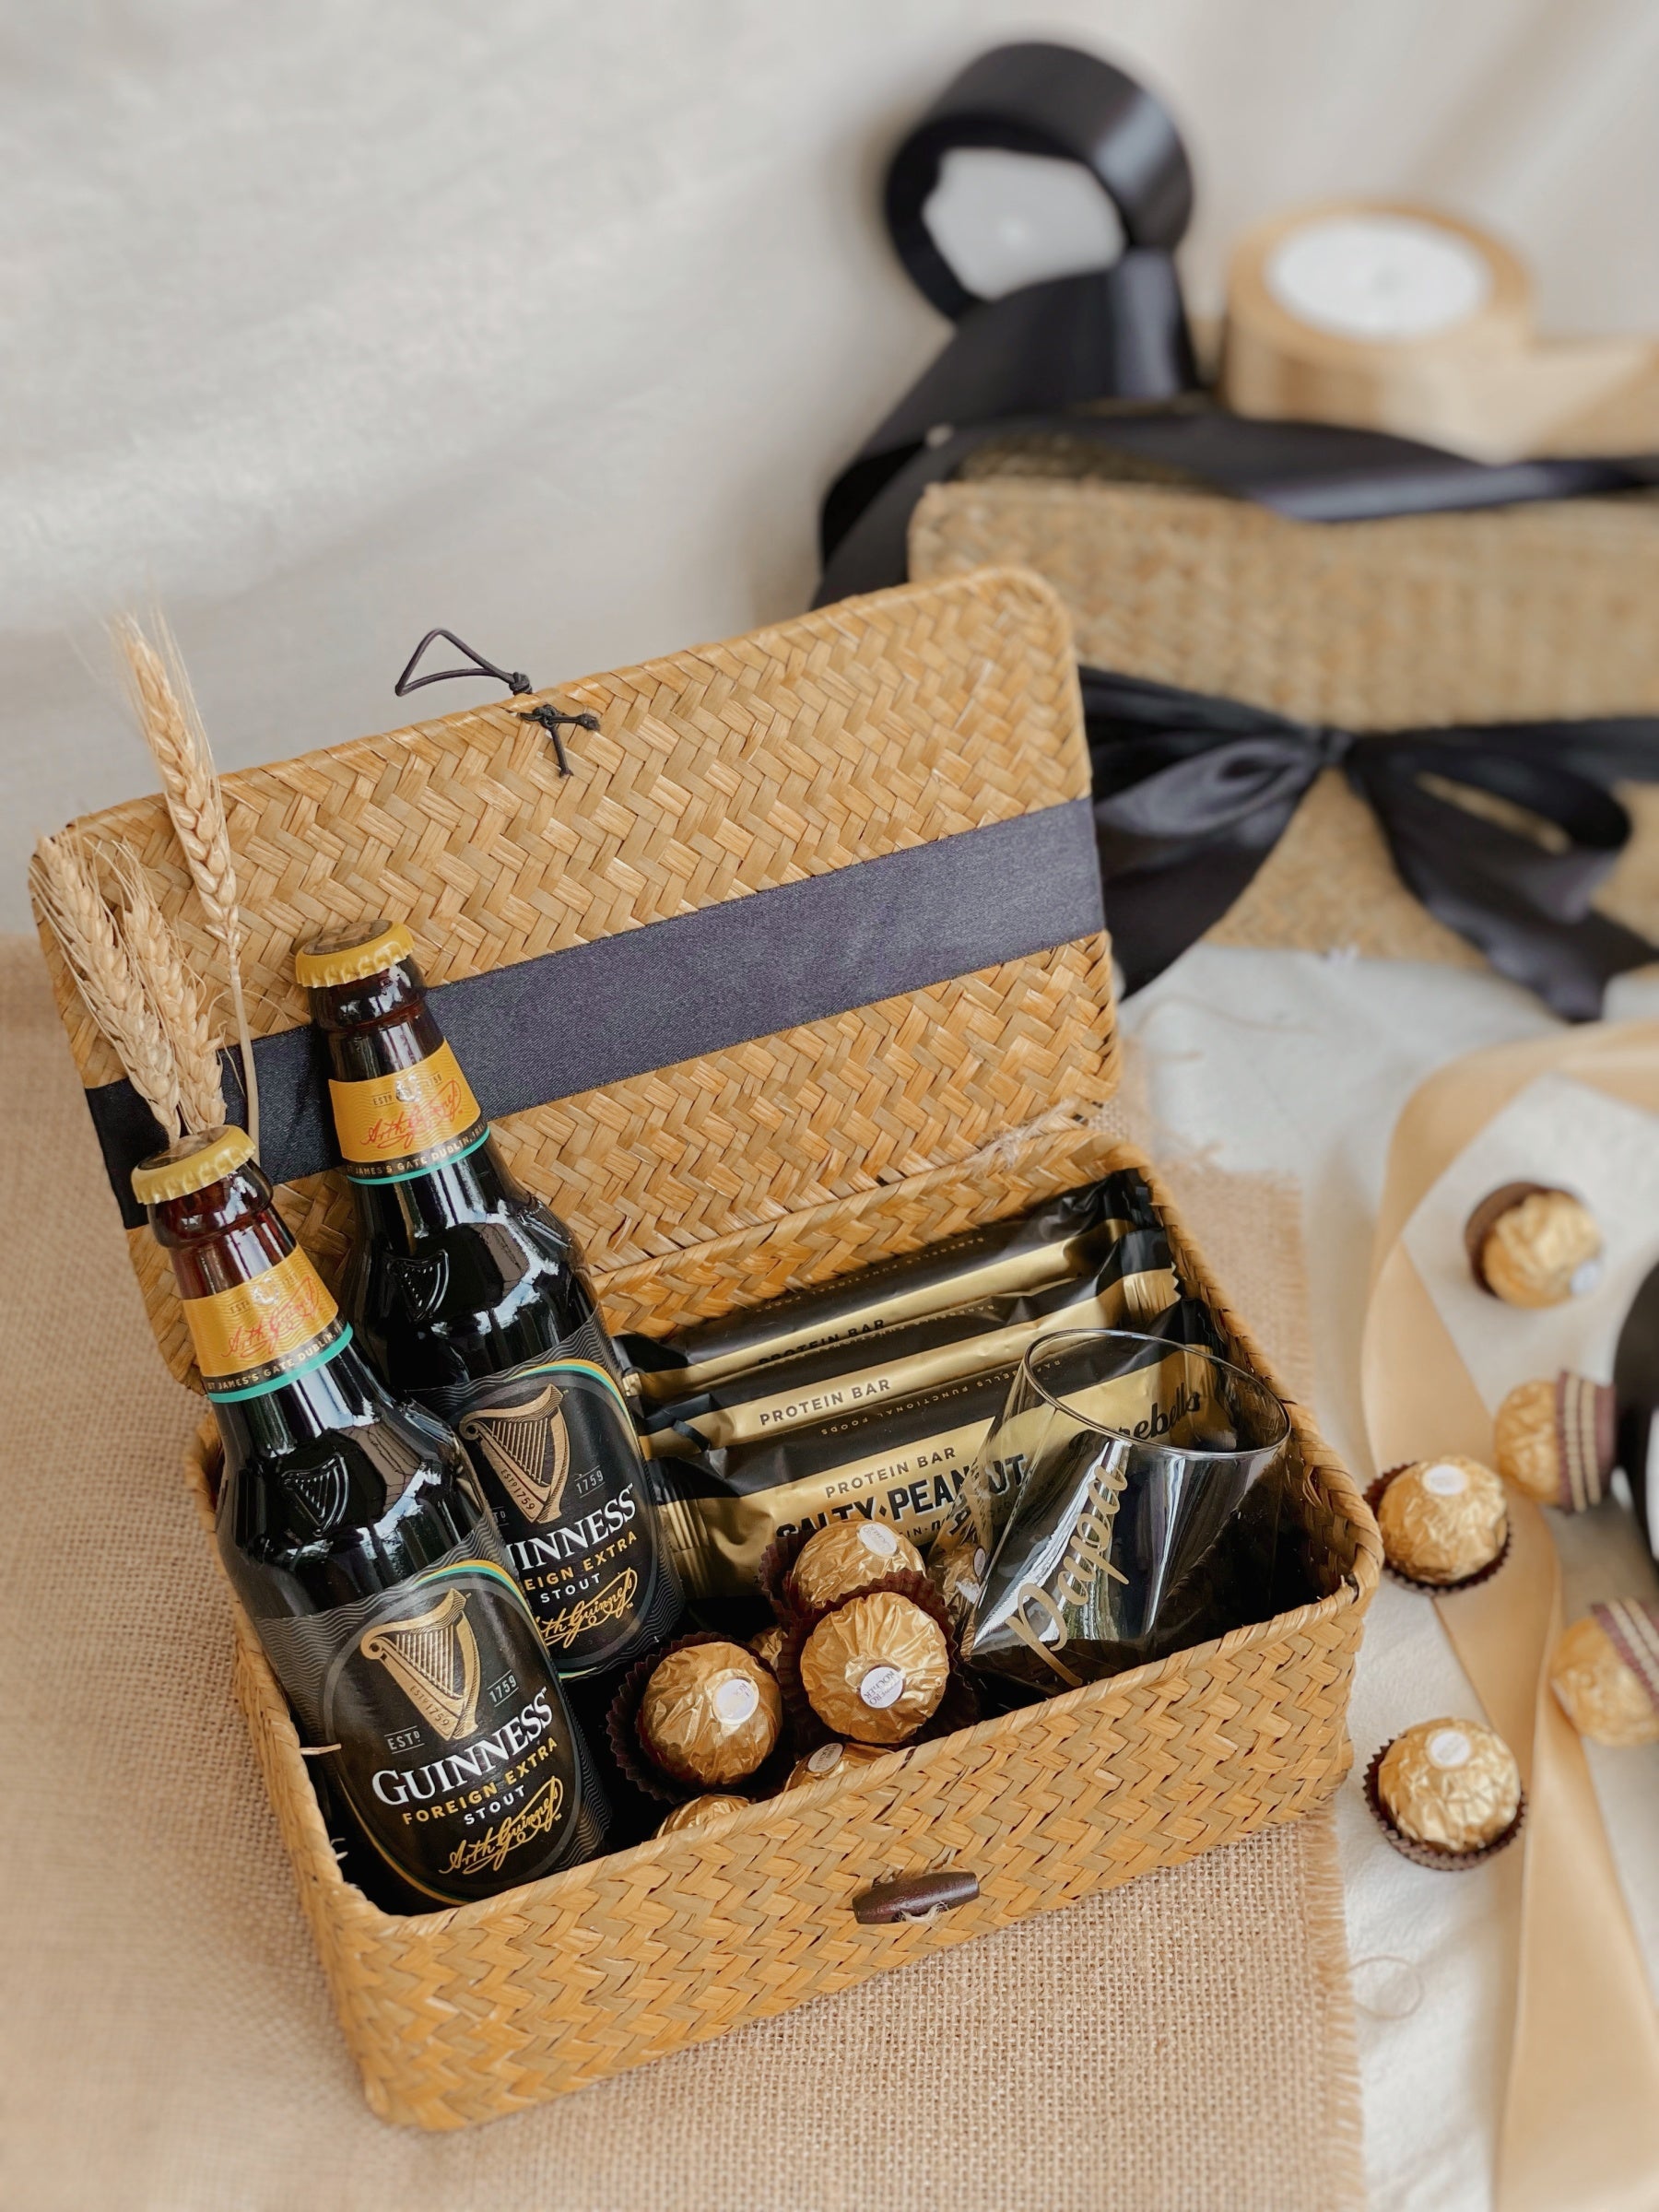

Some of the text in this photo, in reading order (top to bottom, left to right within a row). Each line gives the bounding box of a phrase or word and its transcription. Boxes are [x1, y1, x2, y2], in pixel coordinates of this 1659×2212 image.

[397, 1157, 428, 1171] GATE
[264, 1356, 295, 1377] GATE
[759, 1378, 891, 1427] PROTEIN BAR
[876, 1386, 970, 1419] FUNCTIONAL
[820, 1418, 869, 1436] FOODS
[574, 1470, 605, 1495] 1759
[825, 1446, 957, 1499] PROTEIN BAR
[516, 1485, 537, 1512] 1759
[524, 1530, 638, 1592] EIGN EXTRA
[1005, 1465, 1130, 1688] Papa
[540, 1572, 600, 1604] STOUT
[488, 1674, 519, 1703] 1759
[424, 1703, 450, 1728] 1759
[371, 1691, 553, 1806] GUINNESS
[403, 1736, 559, 1826] FOREIGN EXTRA
[464, 1784, 525, 1825] STOUT
